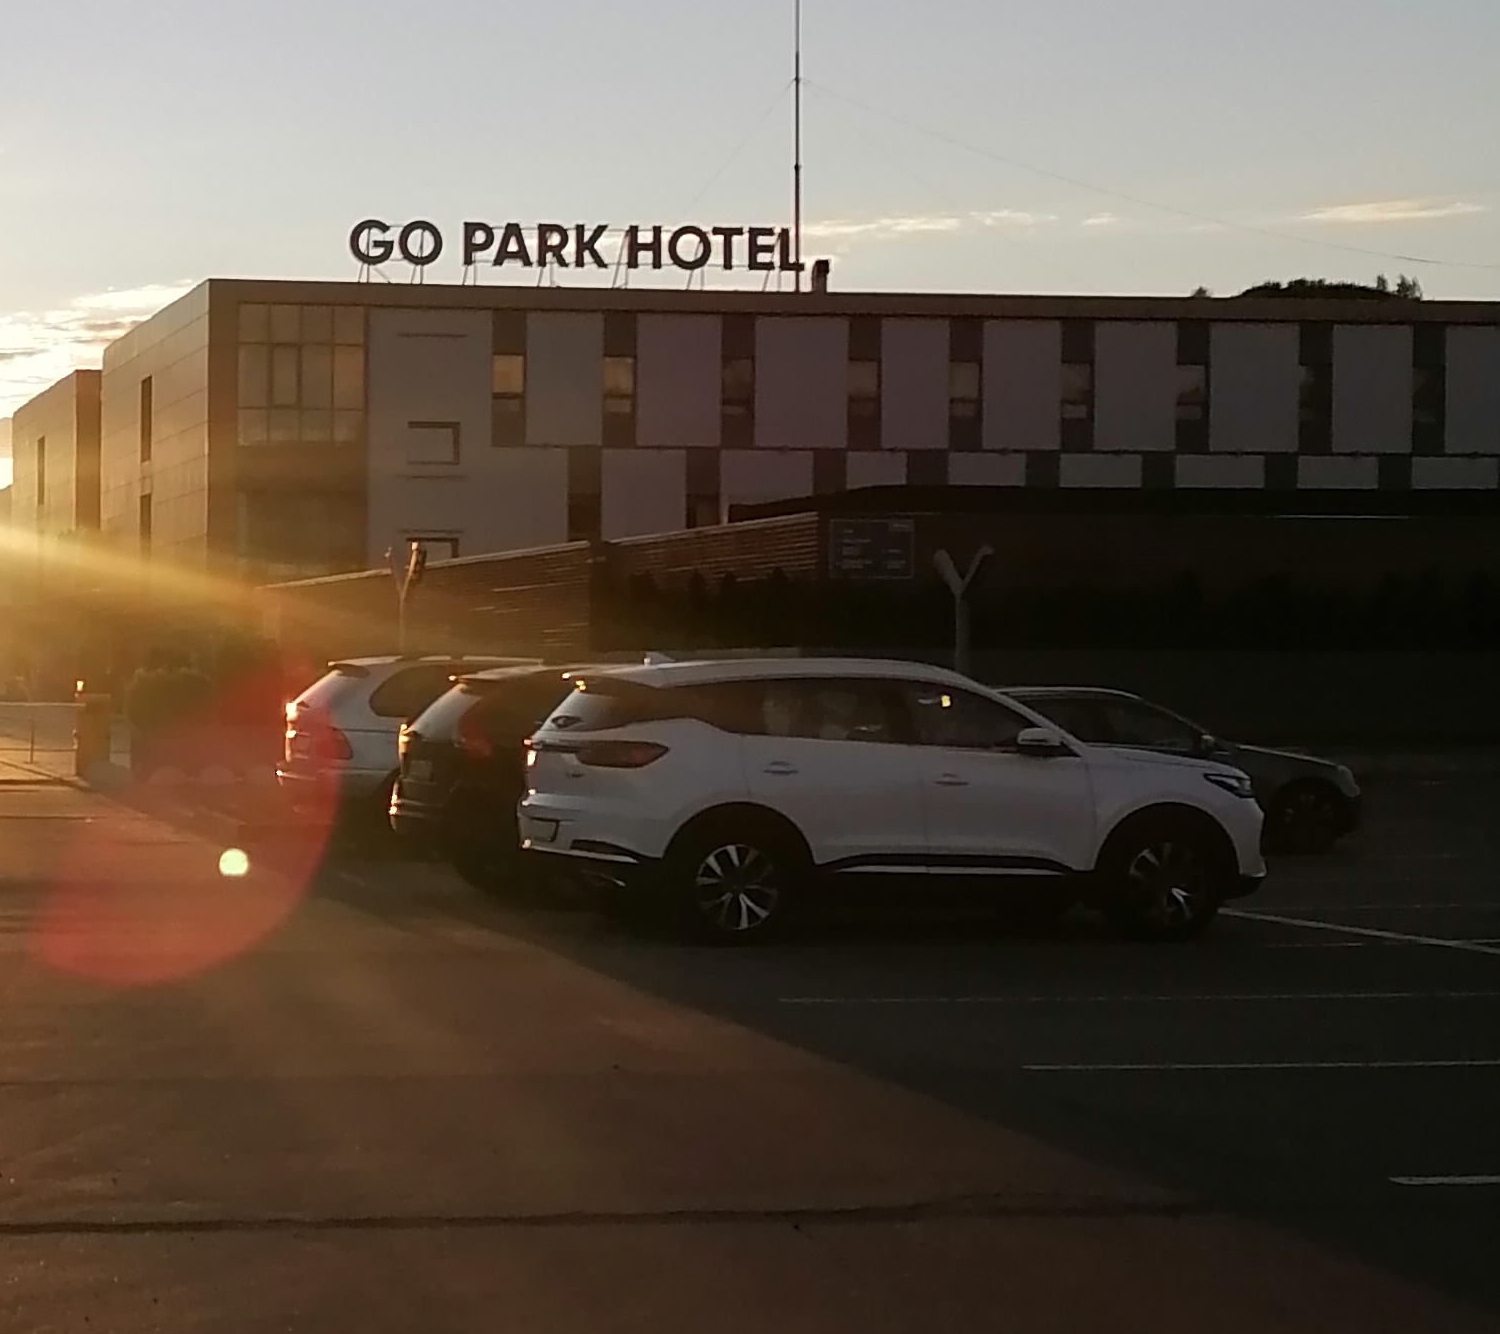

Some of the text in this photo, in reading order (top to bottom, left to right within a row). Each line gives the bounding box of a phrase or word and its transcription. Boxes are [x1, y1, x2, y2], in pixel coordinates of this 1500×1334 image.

[350, 219, 805, 271] GO PARK HOTEL
